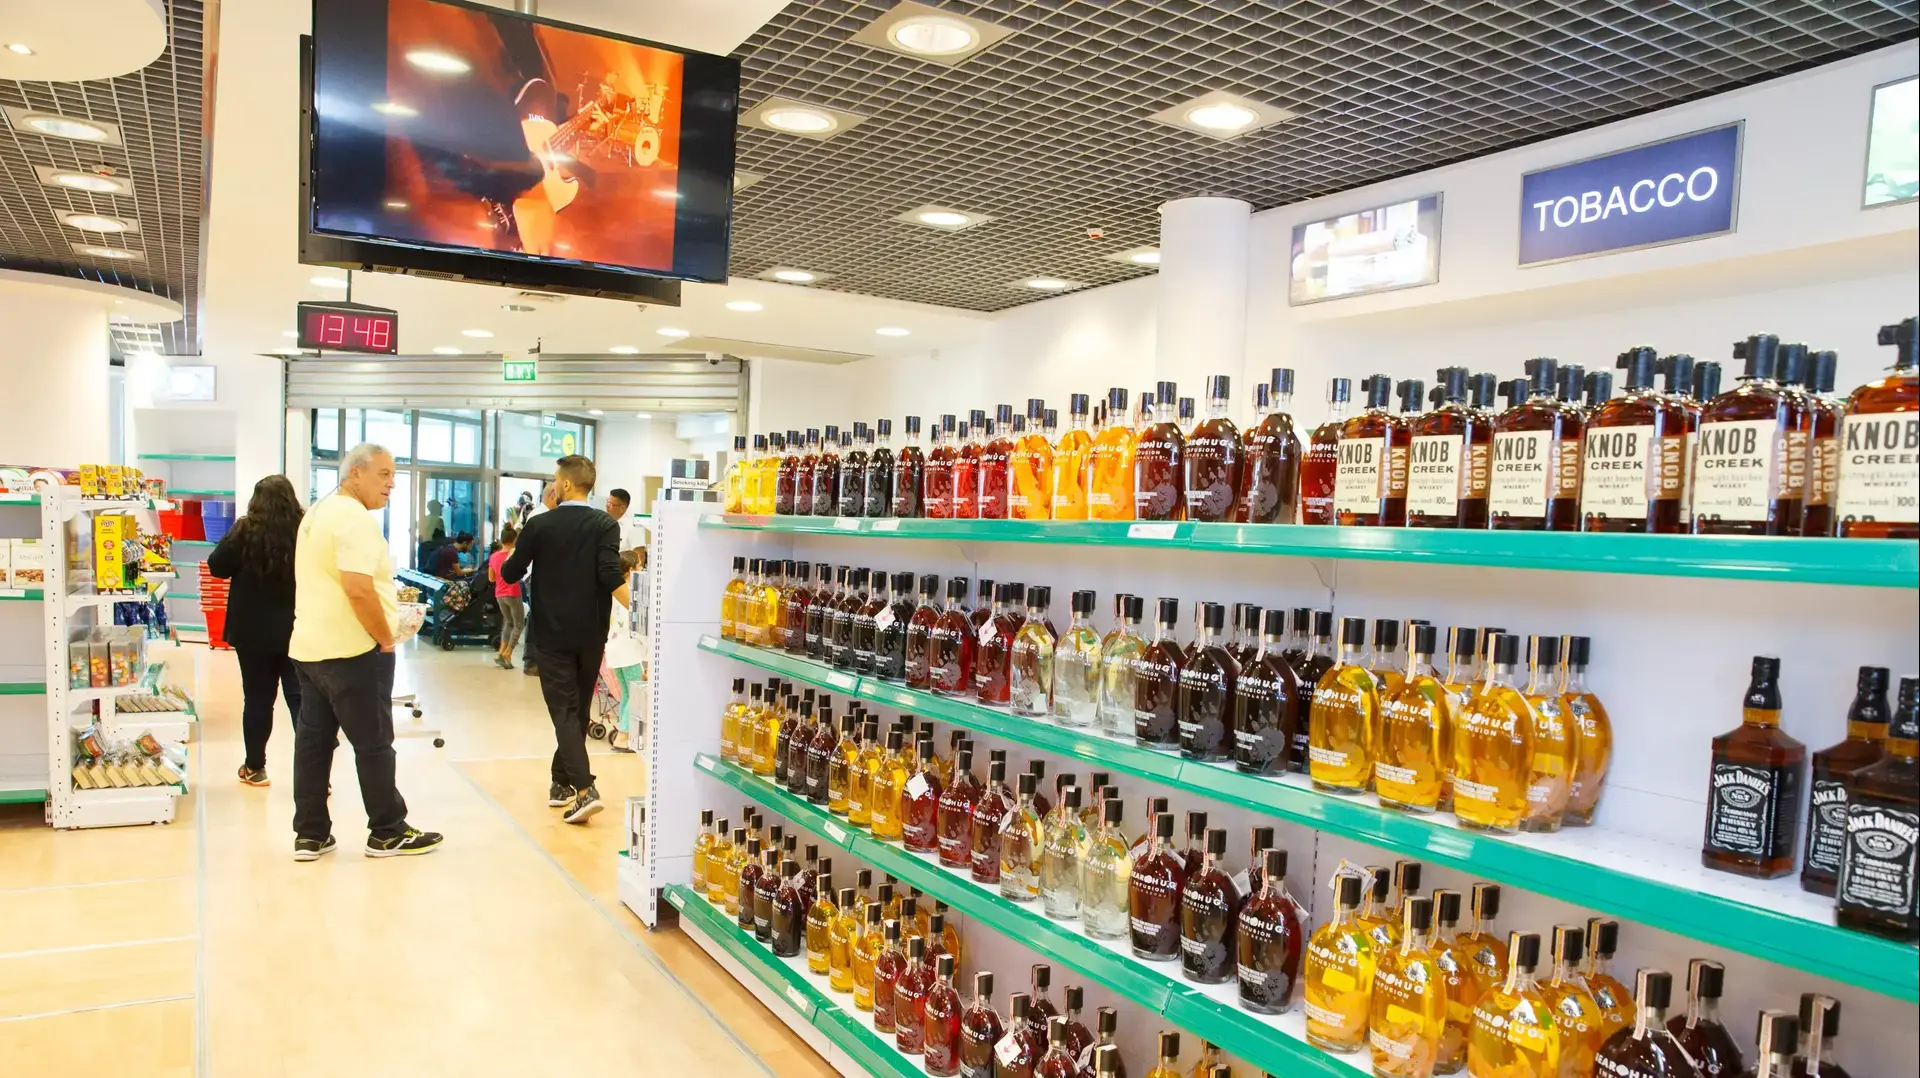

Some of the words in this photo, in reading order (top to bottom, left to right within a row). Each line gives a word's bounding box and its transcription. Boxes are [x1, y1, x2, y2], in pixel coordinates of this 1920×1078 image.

[1533, 166, 1719, 232] TOBACCO
[320, 315, 345, 344] 13
[354, 318, 390, 348] 48
[542, 432, 552, 453] 2
[1701, 428, 1757, 456] KNOB
[1847, 420, 1919, 451] KNOB
[1338, 444, 1373, 464] KNOB
[1411, 441, 1449, 463] KNOB
[1494, 437, 1537, 461] KNOB
[1588, 433, 1637, 459] KNOB
[1472, 445, 1487, 490] KNOB
[1496, 463, 1543, 472] CREEK
[1562, 441, 1578, 489] KNOB
[1591, 461, 1643, 471] CREEK
[1663, 438, 1680, 489] KNOB
[1704, 458, 1764, 469] CREEK
[1789, 432, 1807, 488] KNOB
[1823, 440, 1838, 492] KNOB
[1852, 454, 1919, 465] CREE
[1391, 448, 1406, 490] KNOB
[1413, 466, 1454, 474] CREEK
[1813, 446, 1822, 501] CREEK
[673, 479, 696, 487] Smoking
[1522, 496, 1534, 505] 100
[1621, 496, 1634, 505] 100
[1737, 497, 1752, 507] 100
[1897, 496, 1915, 507] 100
[1714, 773, 1735, 788] JACK
[1736, 770, 1771, 796] DANIEL'S
[1813, 789, 1837, 805] JACK
[1721, 805, 1758, 818] Tennessee
[1721, 817, 1756, 828] WHISKEY
[1847, 815, 1874, 833] JACK
[1875, 812, 1919, 845] DANIEL'S
[1855, 852, 1904, 872] Tennessee
[1152, 879, 1177, 890] HUG
[1855, 868, 1902, 884] WHISKEY
[1133, 881, 1165, 893] INFUSION
[1197, 894, 1221, 906] HUG
[1258, 920, 1284, 933] HUG
[1328, 953, 1358, 967] HUG
[1394, 977, 1425, 995] HUG
[1503, 1019, 1542, 1038] HUG
